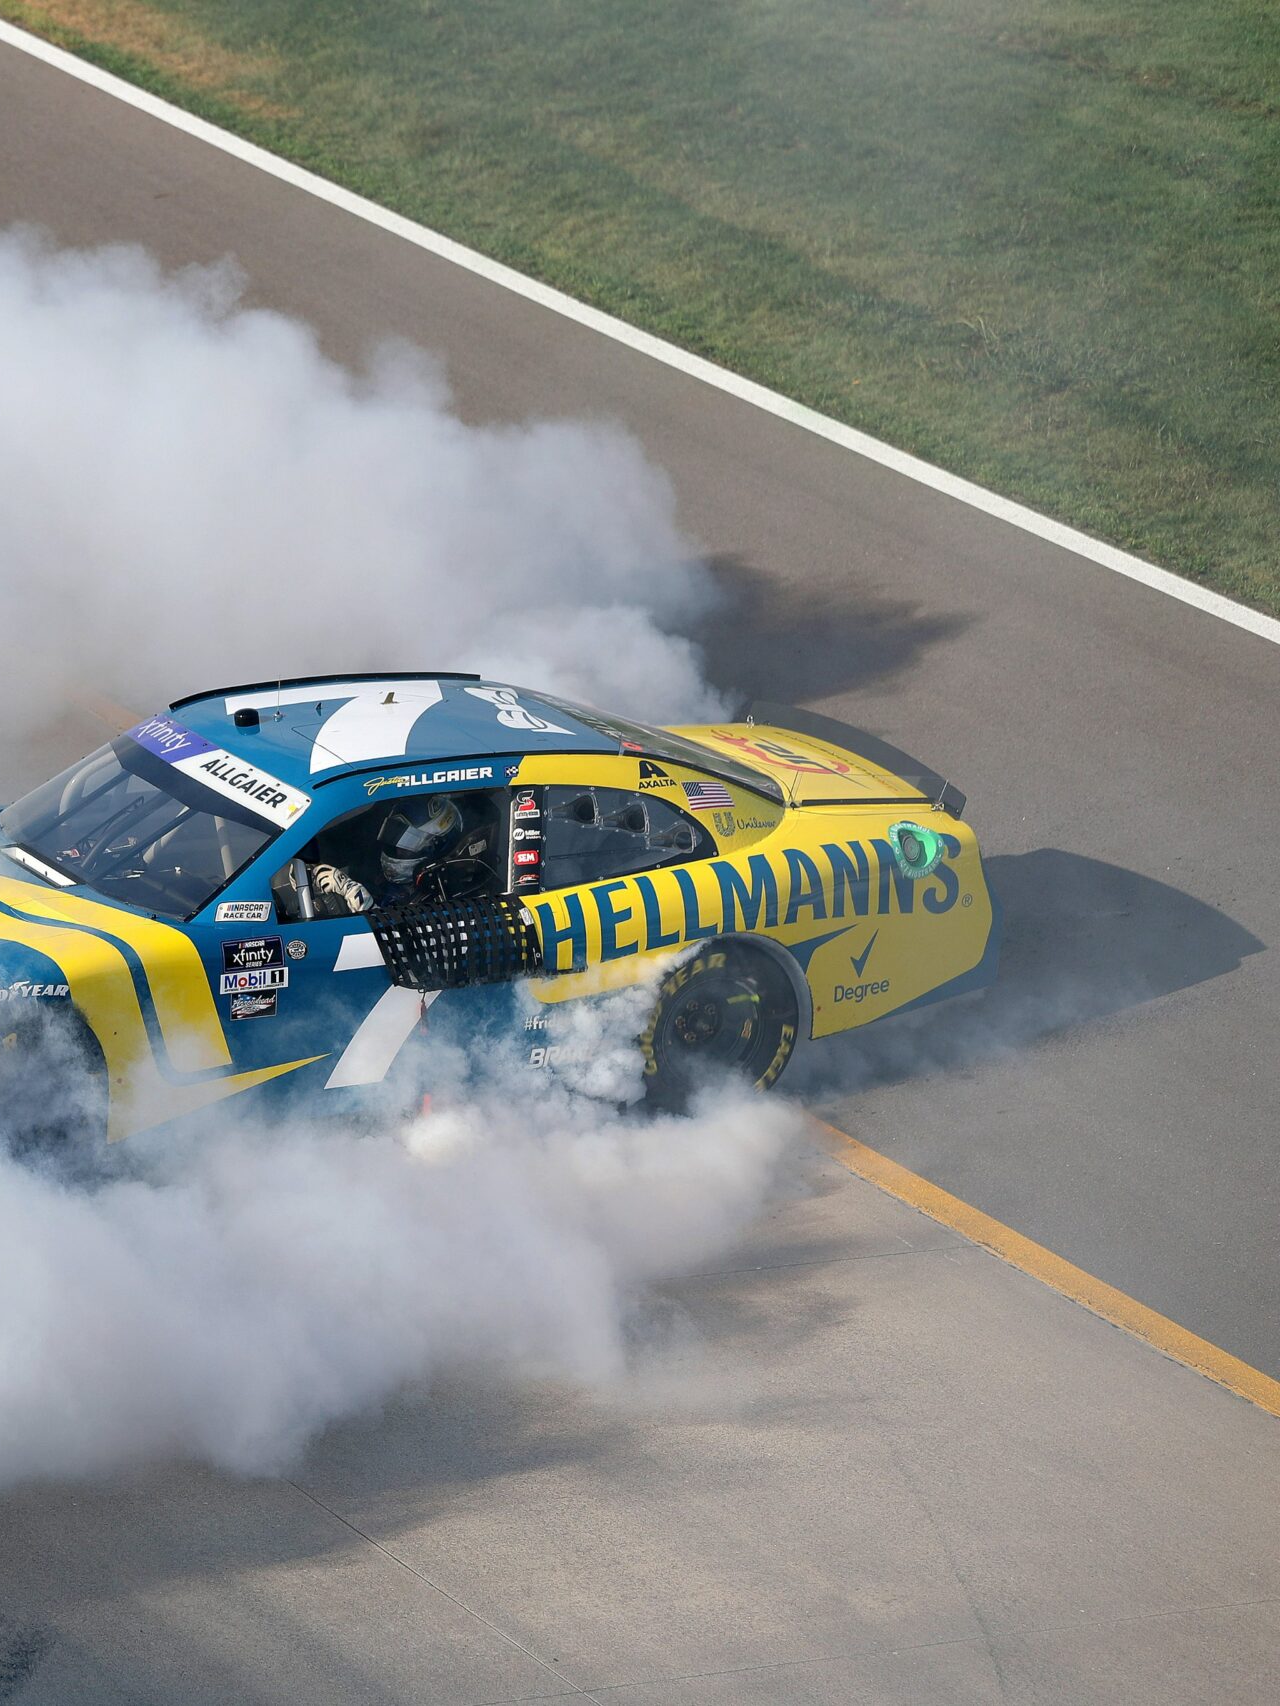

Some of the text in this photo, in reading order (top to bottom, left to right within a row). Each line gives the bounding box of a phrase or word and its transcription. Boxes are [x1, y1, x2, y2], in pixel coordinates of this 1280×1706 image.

[224, 680, 443, 774] 7
[138, 719, 192, 754] xfinity
[200, 758, 288, 809] ALLGAIER
[397, 766, 493, 788] ALLGAIER
[638, 778, 677, 789] AXALTA
[737, 818, 777, 831] Unilever
[517, 853, 535, 863] SEM
[535, 821, 962, 972] HELLMANNS
[229, 903, 264, 912] NASCAR
[241, 940, 266, 949] NASCAR
[232, 948, 274, 966] xfinity
[224, 971, 267, 989] Mobil
[834, 979, 890, 1003] Degree
